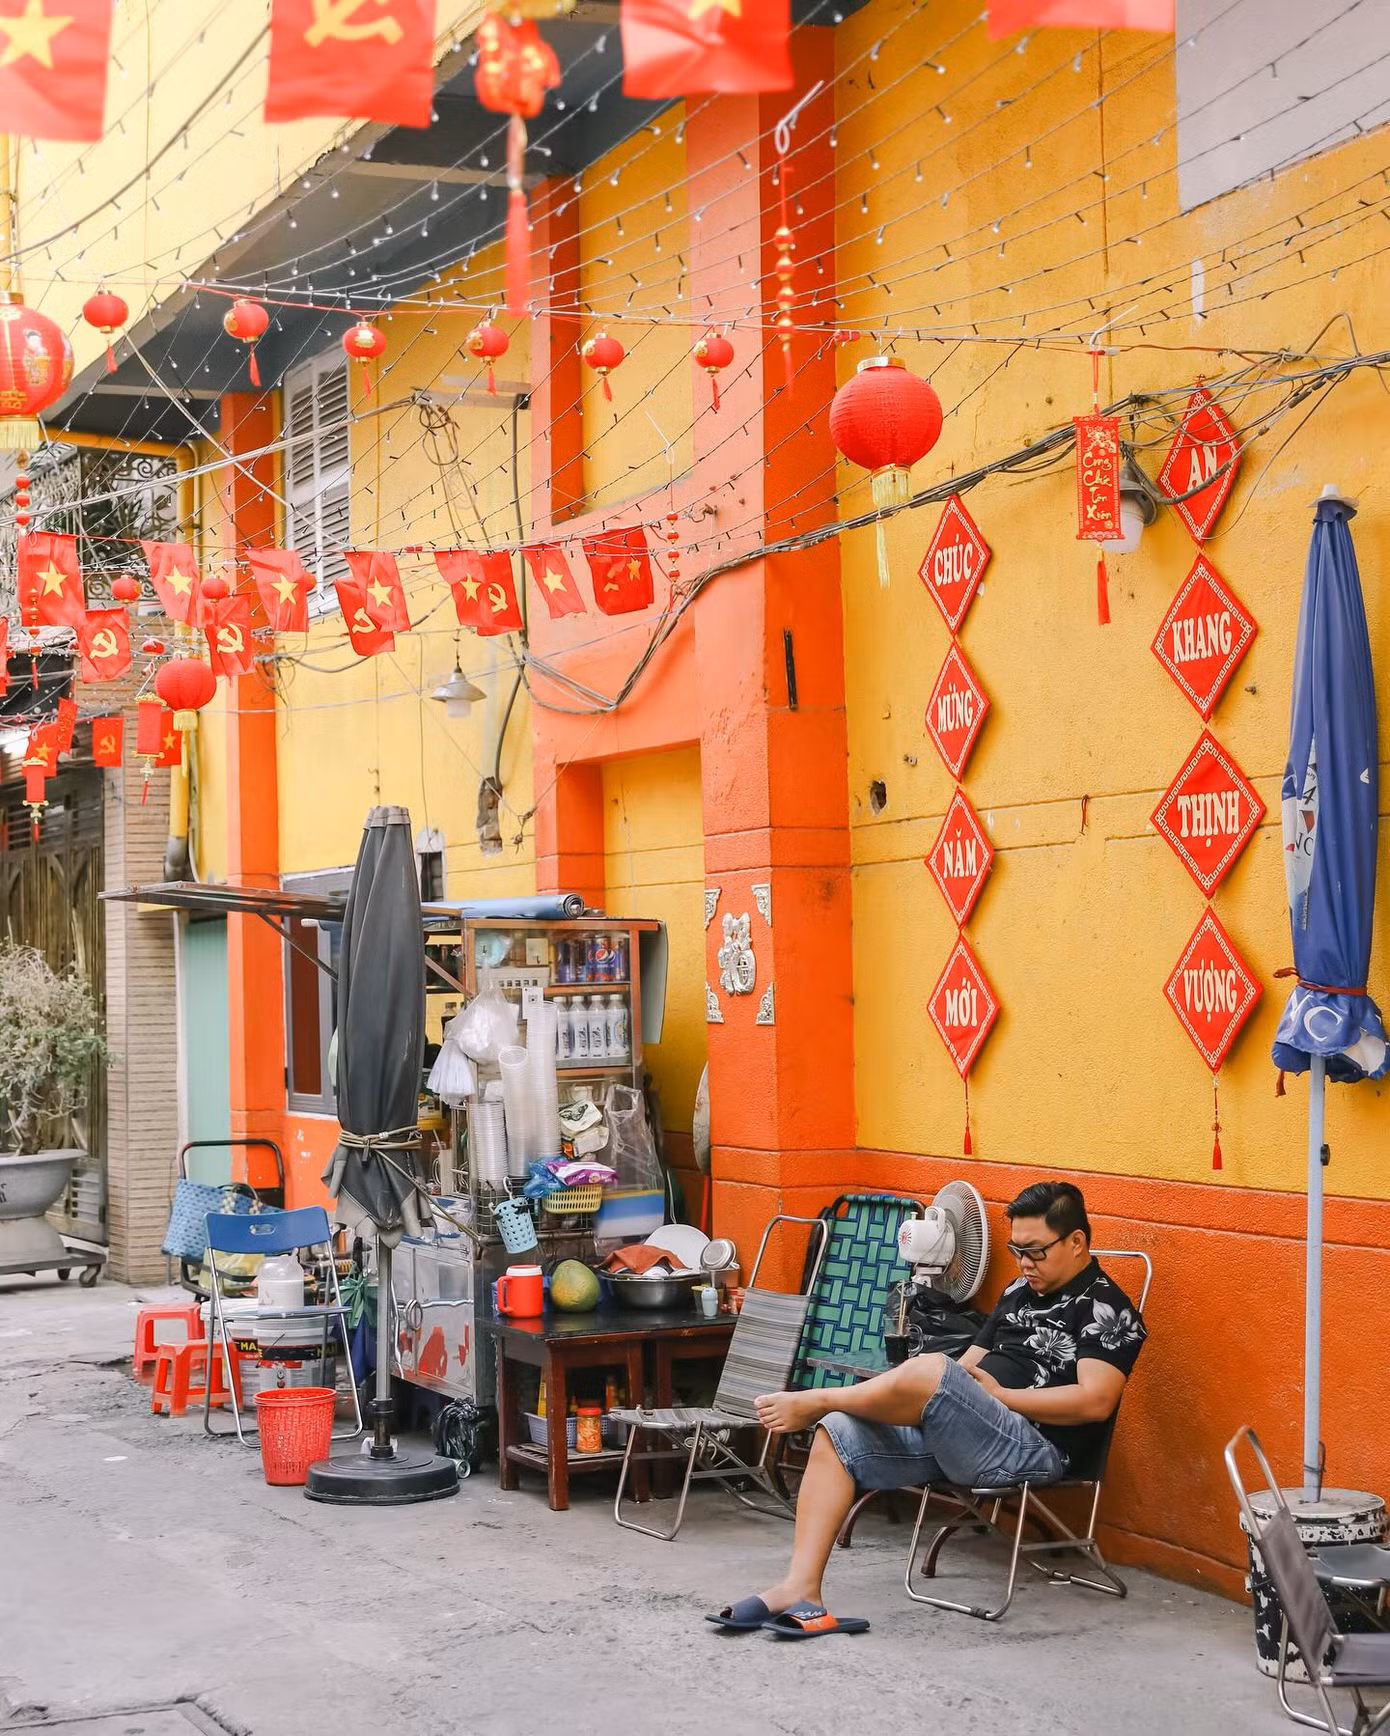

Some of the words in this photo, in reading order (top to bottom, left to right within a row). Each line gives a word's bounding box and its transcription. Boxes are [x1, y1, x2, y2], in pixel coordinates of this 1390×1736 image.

[1187, 441, 1217, 492] AN
[934, 533, 973, 587] CHÚC
[1172, 611, 1232, 664] KHANG
[937, 681, 973, 734] MỪNG
[1177, 790, 1239, 848] THỊNH
[943, 828, 977, 878] NĂM
[945, 977, 978, 1027] MỚI
[1183, 957, 1237, 1023] VƯỢNG
